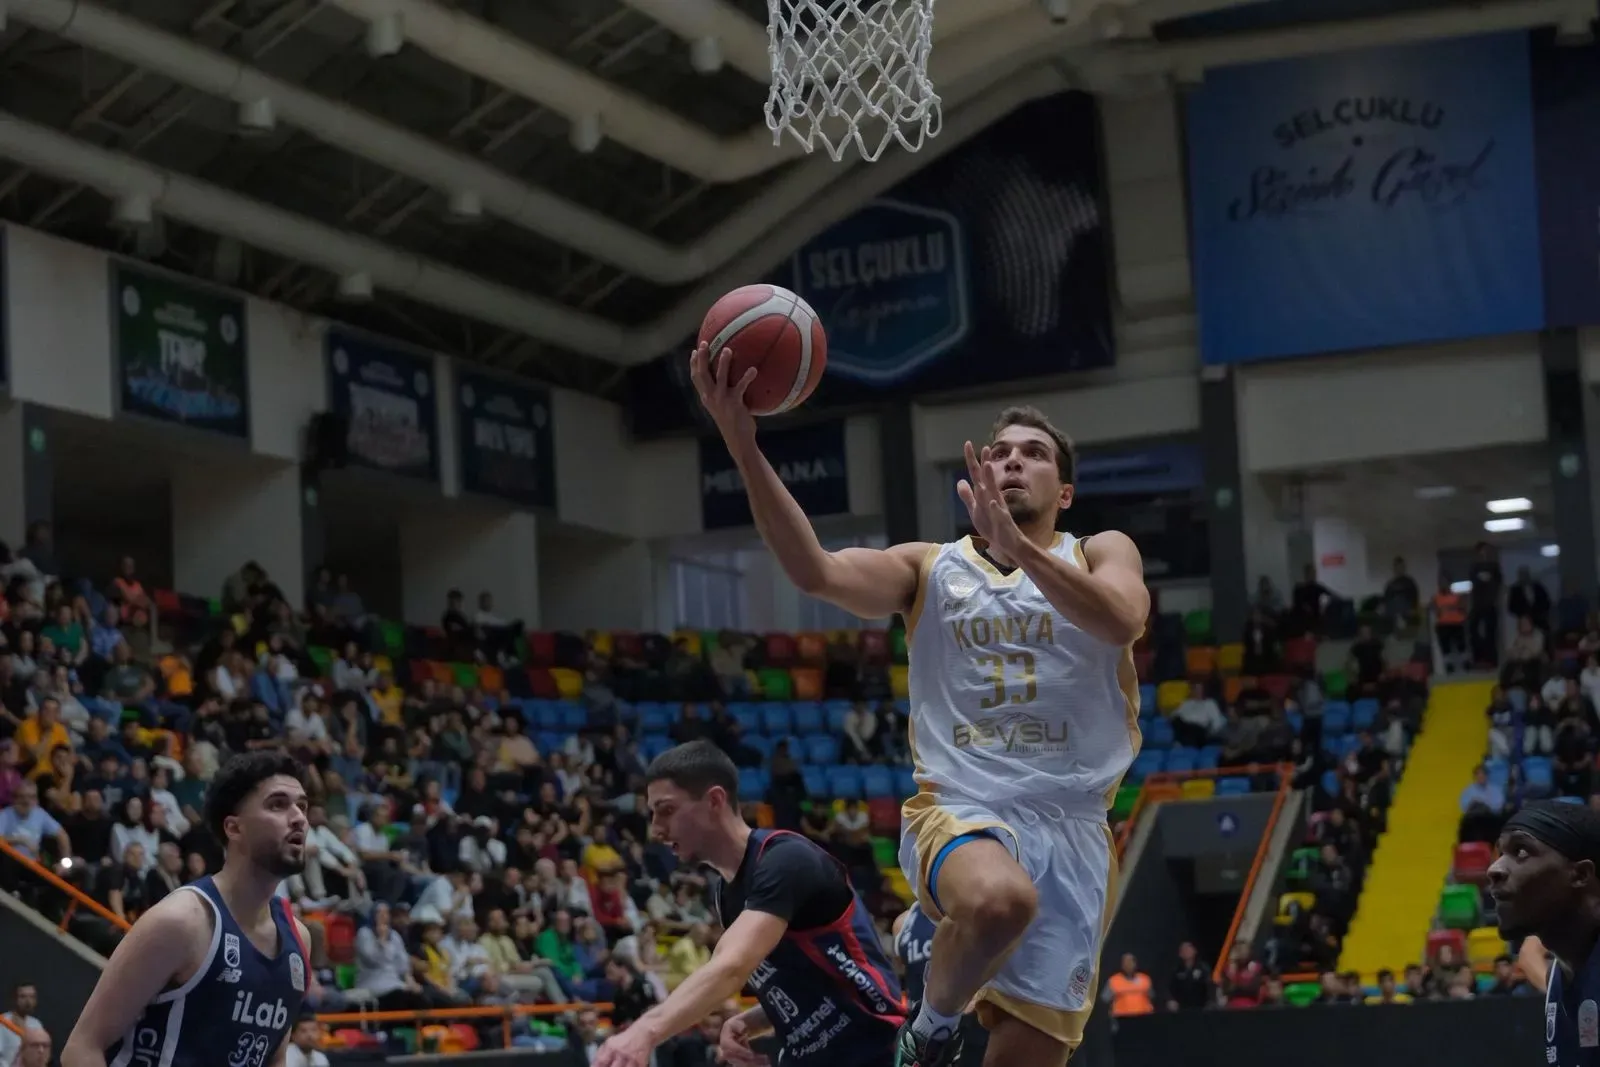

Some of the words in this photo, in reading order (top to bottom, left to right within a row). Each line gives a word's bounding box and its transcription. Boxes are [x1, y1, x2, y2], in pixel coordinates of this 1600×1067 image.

[809, 231, 946, 289] SELÇUKLU
[952, 611, 1055, 652] KONYA
[975, 652, 1037, 709] 33
[906, 939, 932, 965] iLa
[232, 990, 288, 1030] iLab
[228, 1031, 269, 1067] 33
